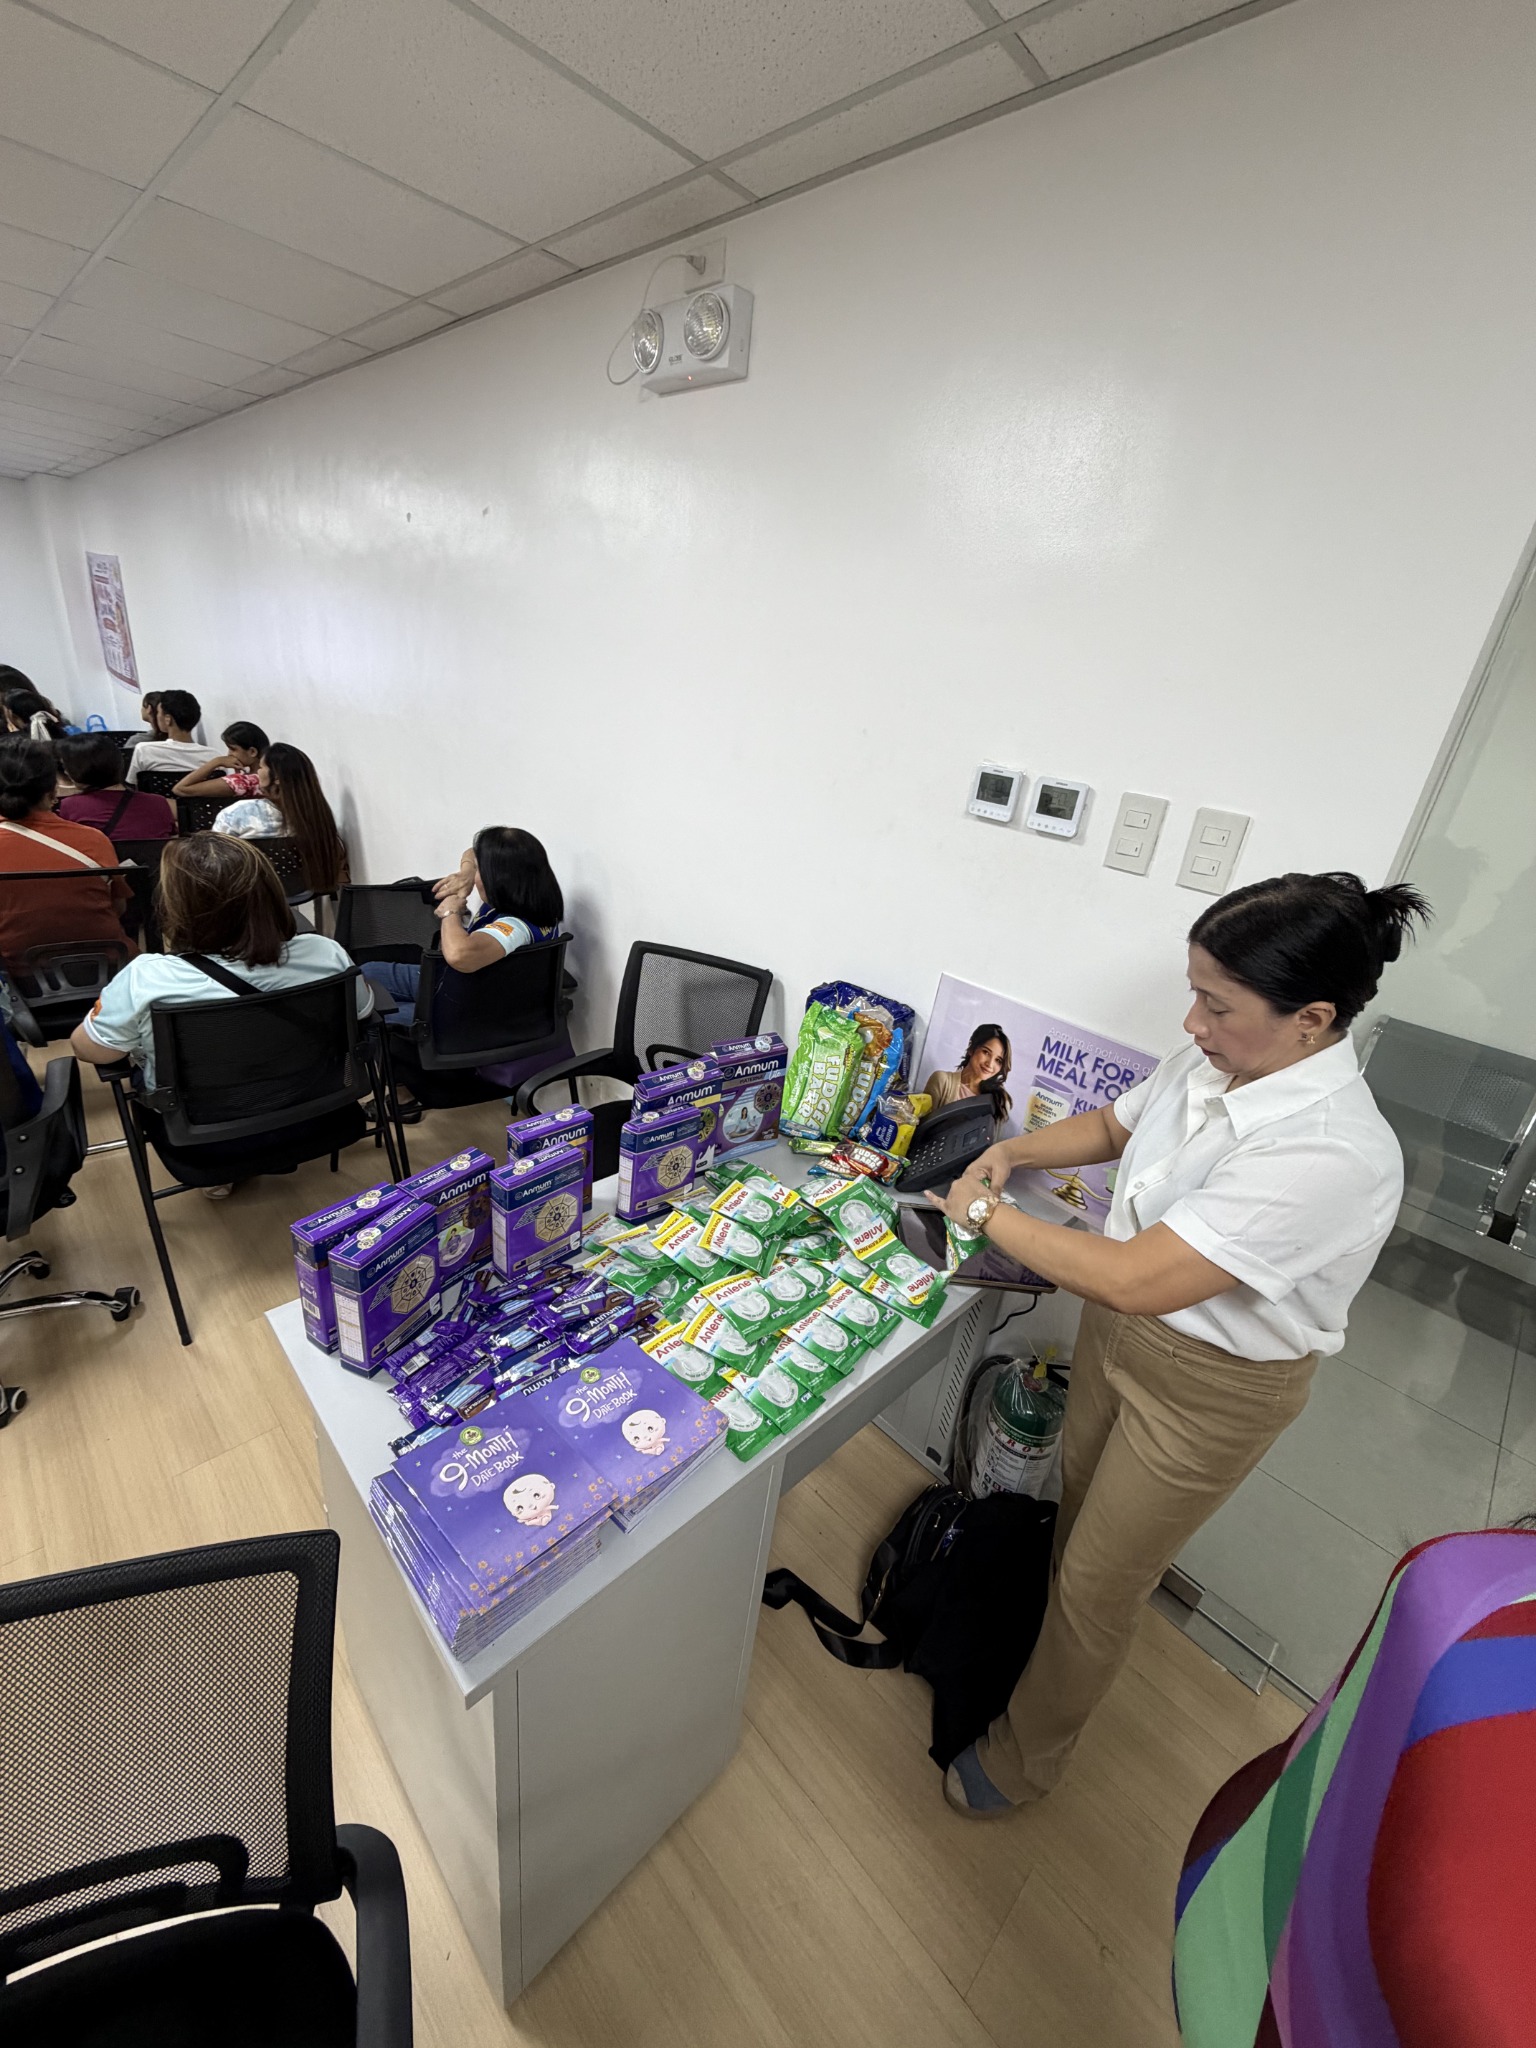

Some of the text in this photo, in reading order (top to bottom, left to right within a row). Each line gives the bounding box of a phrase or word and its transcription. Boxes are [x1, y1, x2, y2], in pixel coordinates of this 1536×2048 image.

[734, 1059, 779, 1078] Anmum
[1042, 1036, 1135, 1089] MILK FOR
[1087, 1044, 1094, 1052] is
[1095, 1047, 1113, 1059] not
[1113, 1050, 1131, 1067] just
[1132, 1062, 1140, 1070] a
[1036, 1053, 1125, 1102] MEAL FO
[667, 1084, 715, 1107] Anmum
[797, 1062, 826, 1119] BARR
[840, 1061, 873, 1130] FUDGE
[1036, 1091, 1064, 1108] Anmum
[542, 1126, 589, 1150] Anmum
[650, 1130, 676, 1143] Anmum
[853, 1146, 884, 1166] FUDGEE
[439, 1171, 489, 1203] Anmum
[523, 1179, 554, 1198] Anmum
[780, 1192, 794, 1205] ABOT
[724, 1190, 748, 1211] Anlene
[317, 1206, 352, 1224] Anmum
[669, 1225, 699, 1250] Anlene
[714, 1222, 731, 1248] Anlene
[853, 1223, 883, 1246] Anlene
[877, 1232, 890, 1243] ABOT
[374, 1244, 407, 1273] Anmum
[716, 1280, 751, 1301] Anlene
[907, 1271, 935, 1293] Anlene
[828, 1288, 854, 1311] Anlene
[589, 1306, 622, 1327] Anmum
[699, 1313, 725, 1343] Anlene
[793, 1311, 821, 1334] Anlene
[646, 1342, 661, 1354] ABOT
[656, 1340, 685, 1359] Anle
[522, 1375, 554, 1397] Anmu
[565, 1371, 632, 1422] 9-MONTH
[576, 1385, 588, 1396] the
[592, 1389, 638, 1419] DATE BOOK
[439, 1431, 519, 1491] 9-MONTH
[452, 1448, 468, 1460] the
[470, 1451, 525, 1487] DATE BOOK
